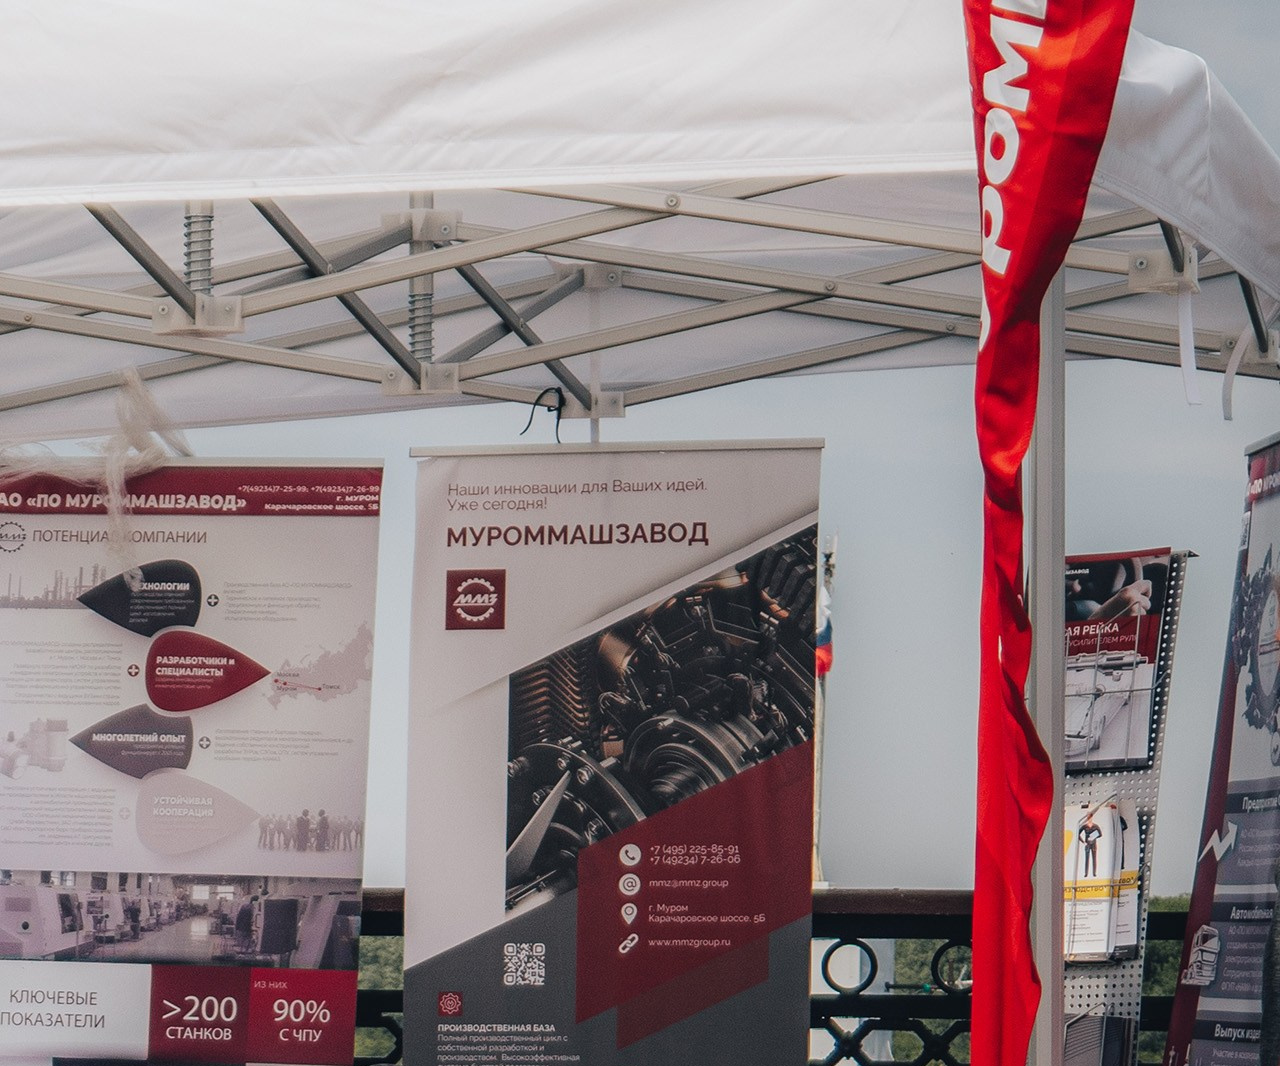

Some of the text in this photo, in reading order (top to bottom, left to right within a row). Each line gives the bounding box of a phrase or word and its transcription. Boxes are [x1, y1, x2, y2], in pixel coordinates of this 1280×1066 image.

[979, 0, 1047, 352] РОМ
[448, 478, 708, 497] Наши инновации для Ваших идей.
[27, 493, 61, 508] «ПО
[66, 494, 246, 511] МУРММАШЗАВОД»
[448, 498, 548, 511] Уже сегодня!
[32, 530, 207, 544] ПОТЕНЦИА ОМПАНИИ
[447, 522, 709, 547] МУРОММАШЗАВОД
[132, 582, 190, 591] ХНОЛОГИИ
[1082, 622, 1119, 635] РЕЙКА
[156, 657, 227, 665] РАЗРАБОТЧИКИ
[156, 668, 223, 676] СПЕЦИАЛИСТЫ
[92, 733, 186, 742] МНОГОЛЕТНИЙ ОПЫТ
[153, 794, 213, 805] УСТОЙЧИВАЯ
[153, 807, 214, 819] КООПЕРАЦИЯ
[650, 845, 739, 855] +7 (495) 225-85-91
[650, 855, 741, 865] +7 (49234) 7-26-06
[649, 879, 729, 888] mmz@mmz.group
[657, 904, 688, 913] Муром
[649, 914, 766, 923] Карачаровское 5Б
[648, 939, 731, 947] www.mmzgroup.ru
[9, 990, 98, 1006] КЛЮЧЕВЫЕ
[162, 995, 238, 1022] >200
[273, 999, 331, 1023] 90%
[0, 1012, 105, 1029] ПОКАЗАТЕЛИ
[438, 1024, 555, 1032] ПРОИЗВОДСТВЕННАЯ БАЗА
[1214, 1023, 1245, 1041] Выпуск
[166, 1027, 232, 1041] СТАНКОВ
[279, 1028, 322, 1042] С ЧПУ
[469, 1034, 542, 1043] производственный
[489, 1044, 538, 1052] разработкой
[502, 1054, 580, 1062] Высокоэффективная
